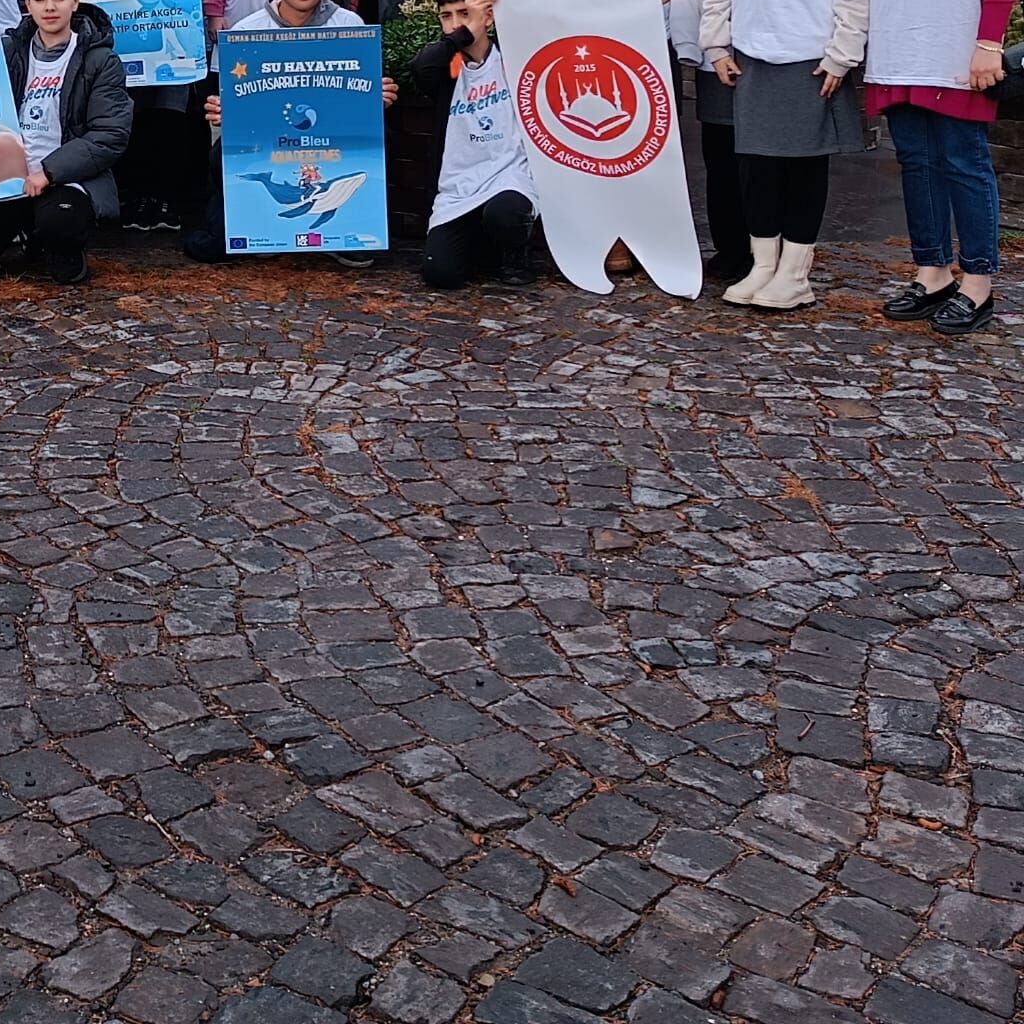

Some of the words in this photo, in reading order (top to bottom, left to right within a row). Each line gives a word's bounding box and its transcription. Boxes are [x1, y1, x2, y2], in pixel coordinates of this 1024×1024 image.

[116, 9, 150, 21] NEYİRE
[131, 20, 189, 33] ORTAOKULU
[261, 62, 281, 74] SU
[284, 59, 361, 74] HAYATTIR
[573, 63, 597, 74] 2015
[312, 74, 343, 89] HAYATI
[346, 77, 373, 93] KORU
[519, 70, 536, 116] OSMAN
[637, 64, 668, 137] ORTAOKULU
[278, 135, 330, 148] ProBleu
[469, 133, 504, 142] ProBleu
[526, 117, 558, 155] NEYİRE
[554, 150, 597, 174] AKGÖZ
[598, 137, 662, 176] İMAM-HATİP
